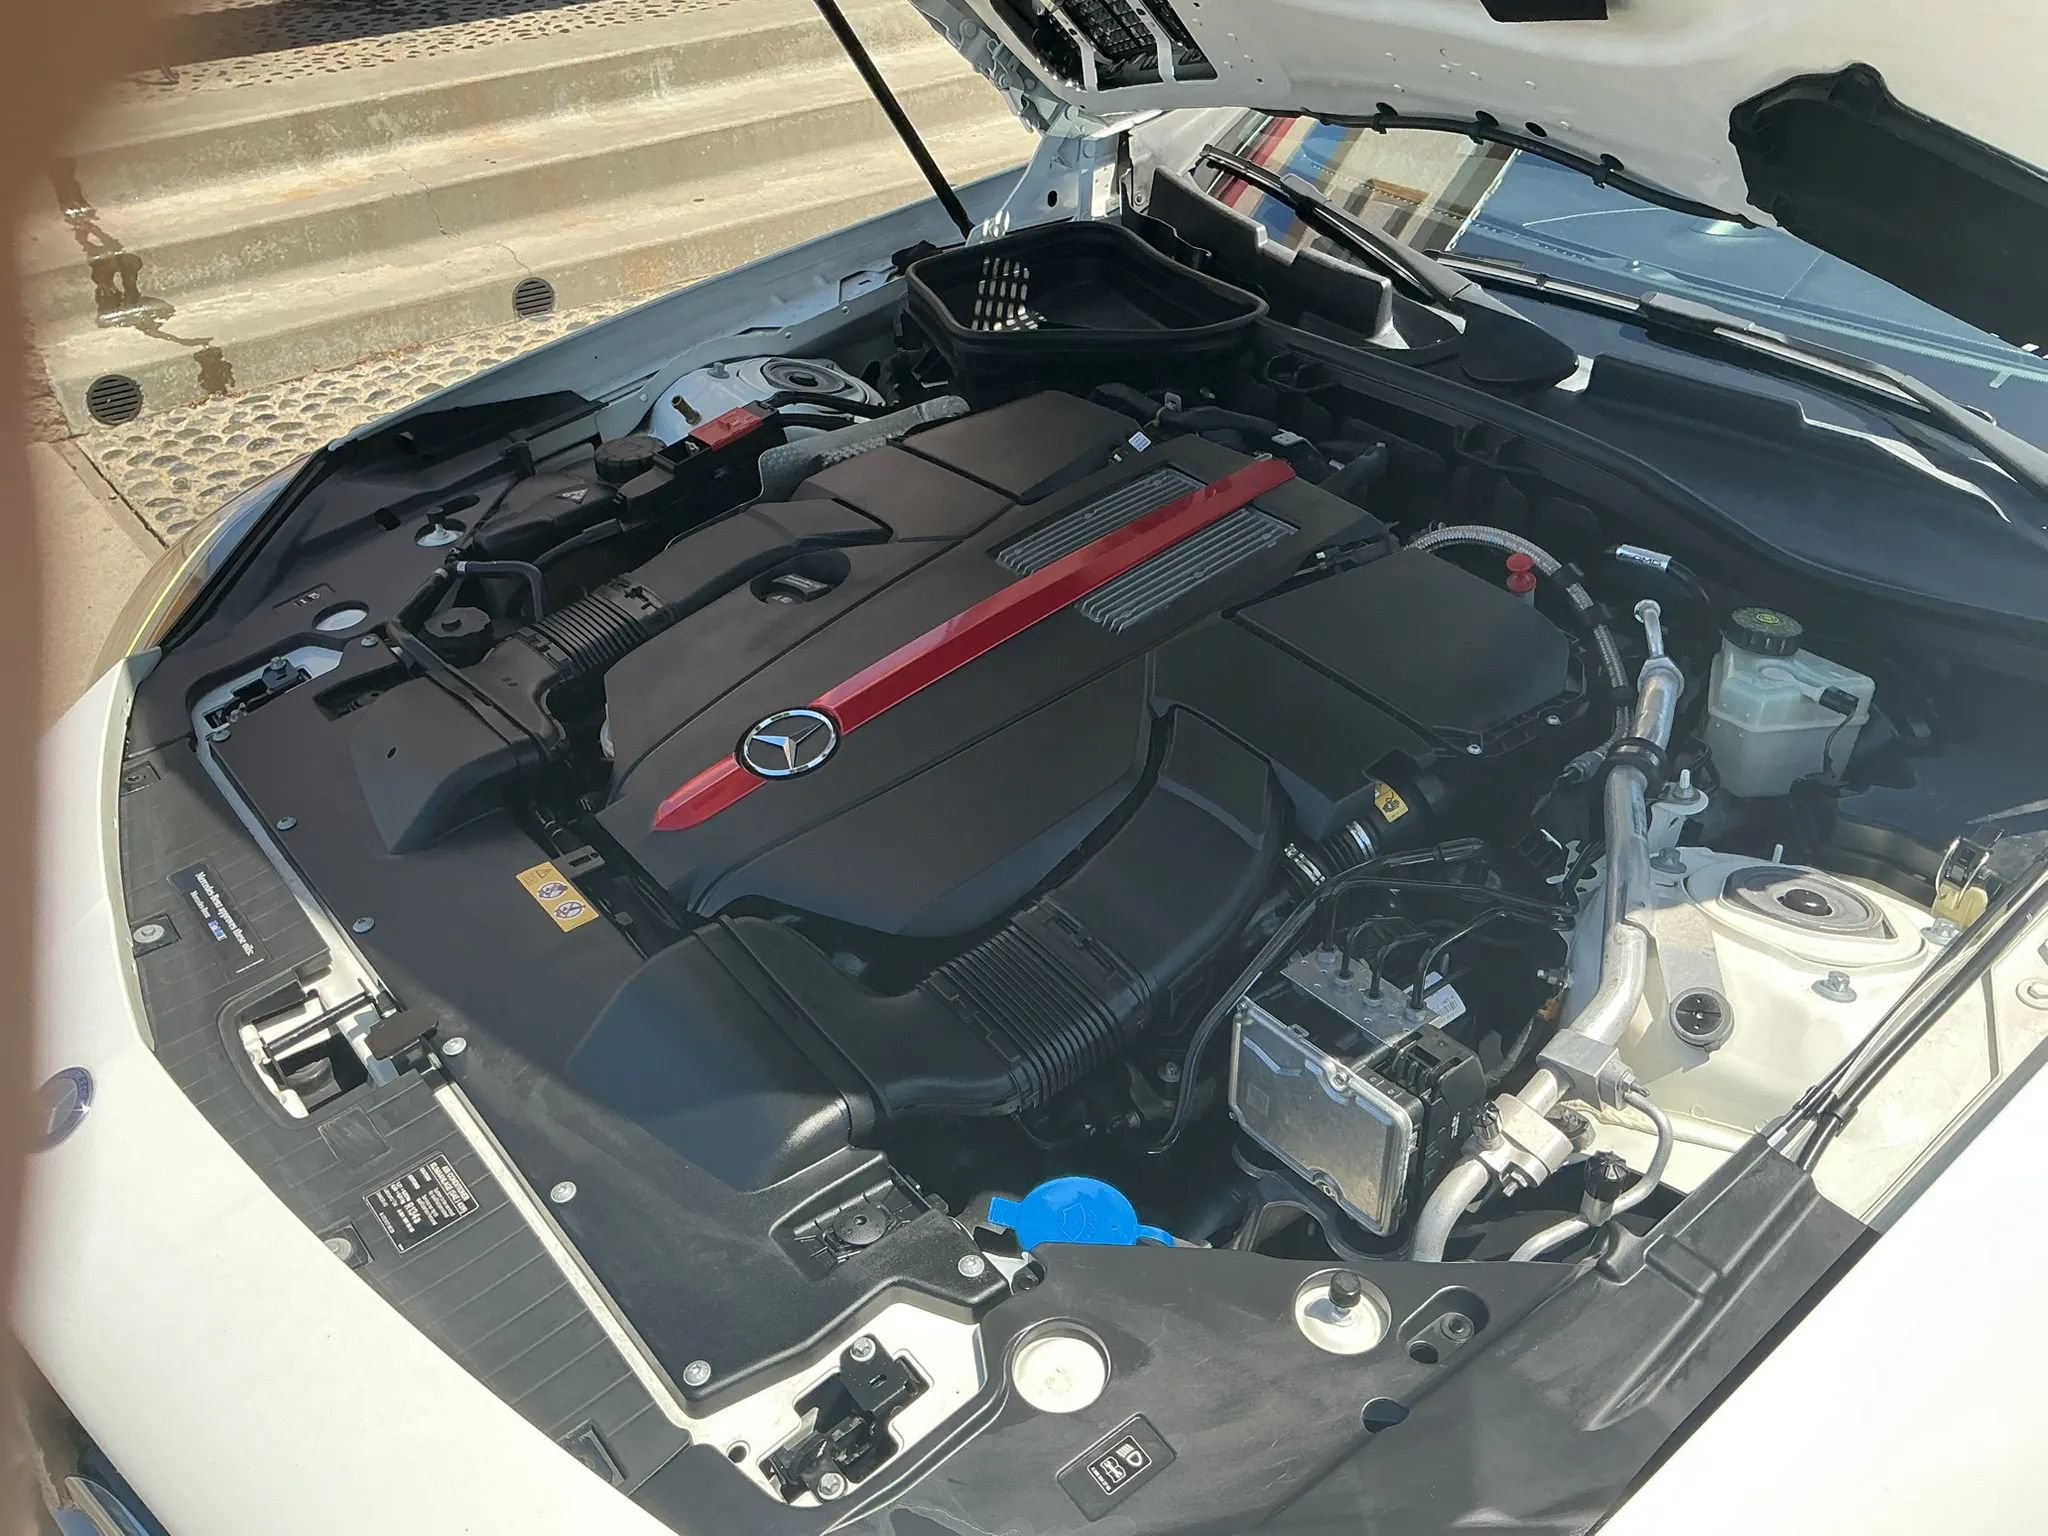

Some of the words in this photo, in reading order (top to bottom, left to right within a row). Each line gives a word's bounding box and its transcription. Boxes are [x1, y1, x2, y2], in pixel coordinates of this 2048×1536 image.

[194, 871, 225, 909] Mercedes-Benz
[216, 906, 238, 931] approves
[231, 928, 249, 944] these
[402, 1200, 424, 1223] R134a
